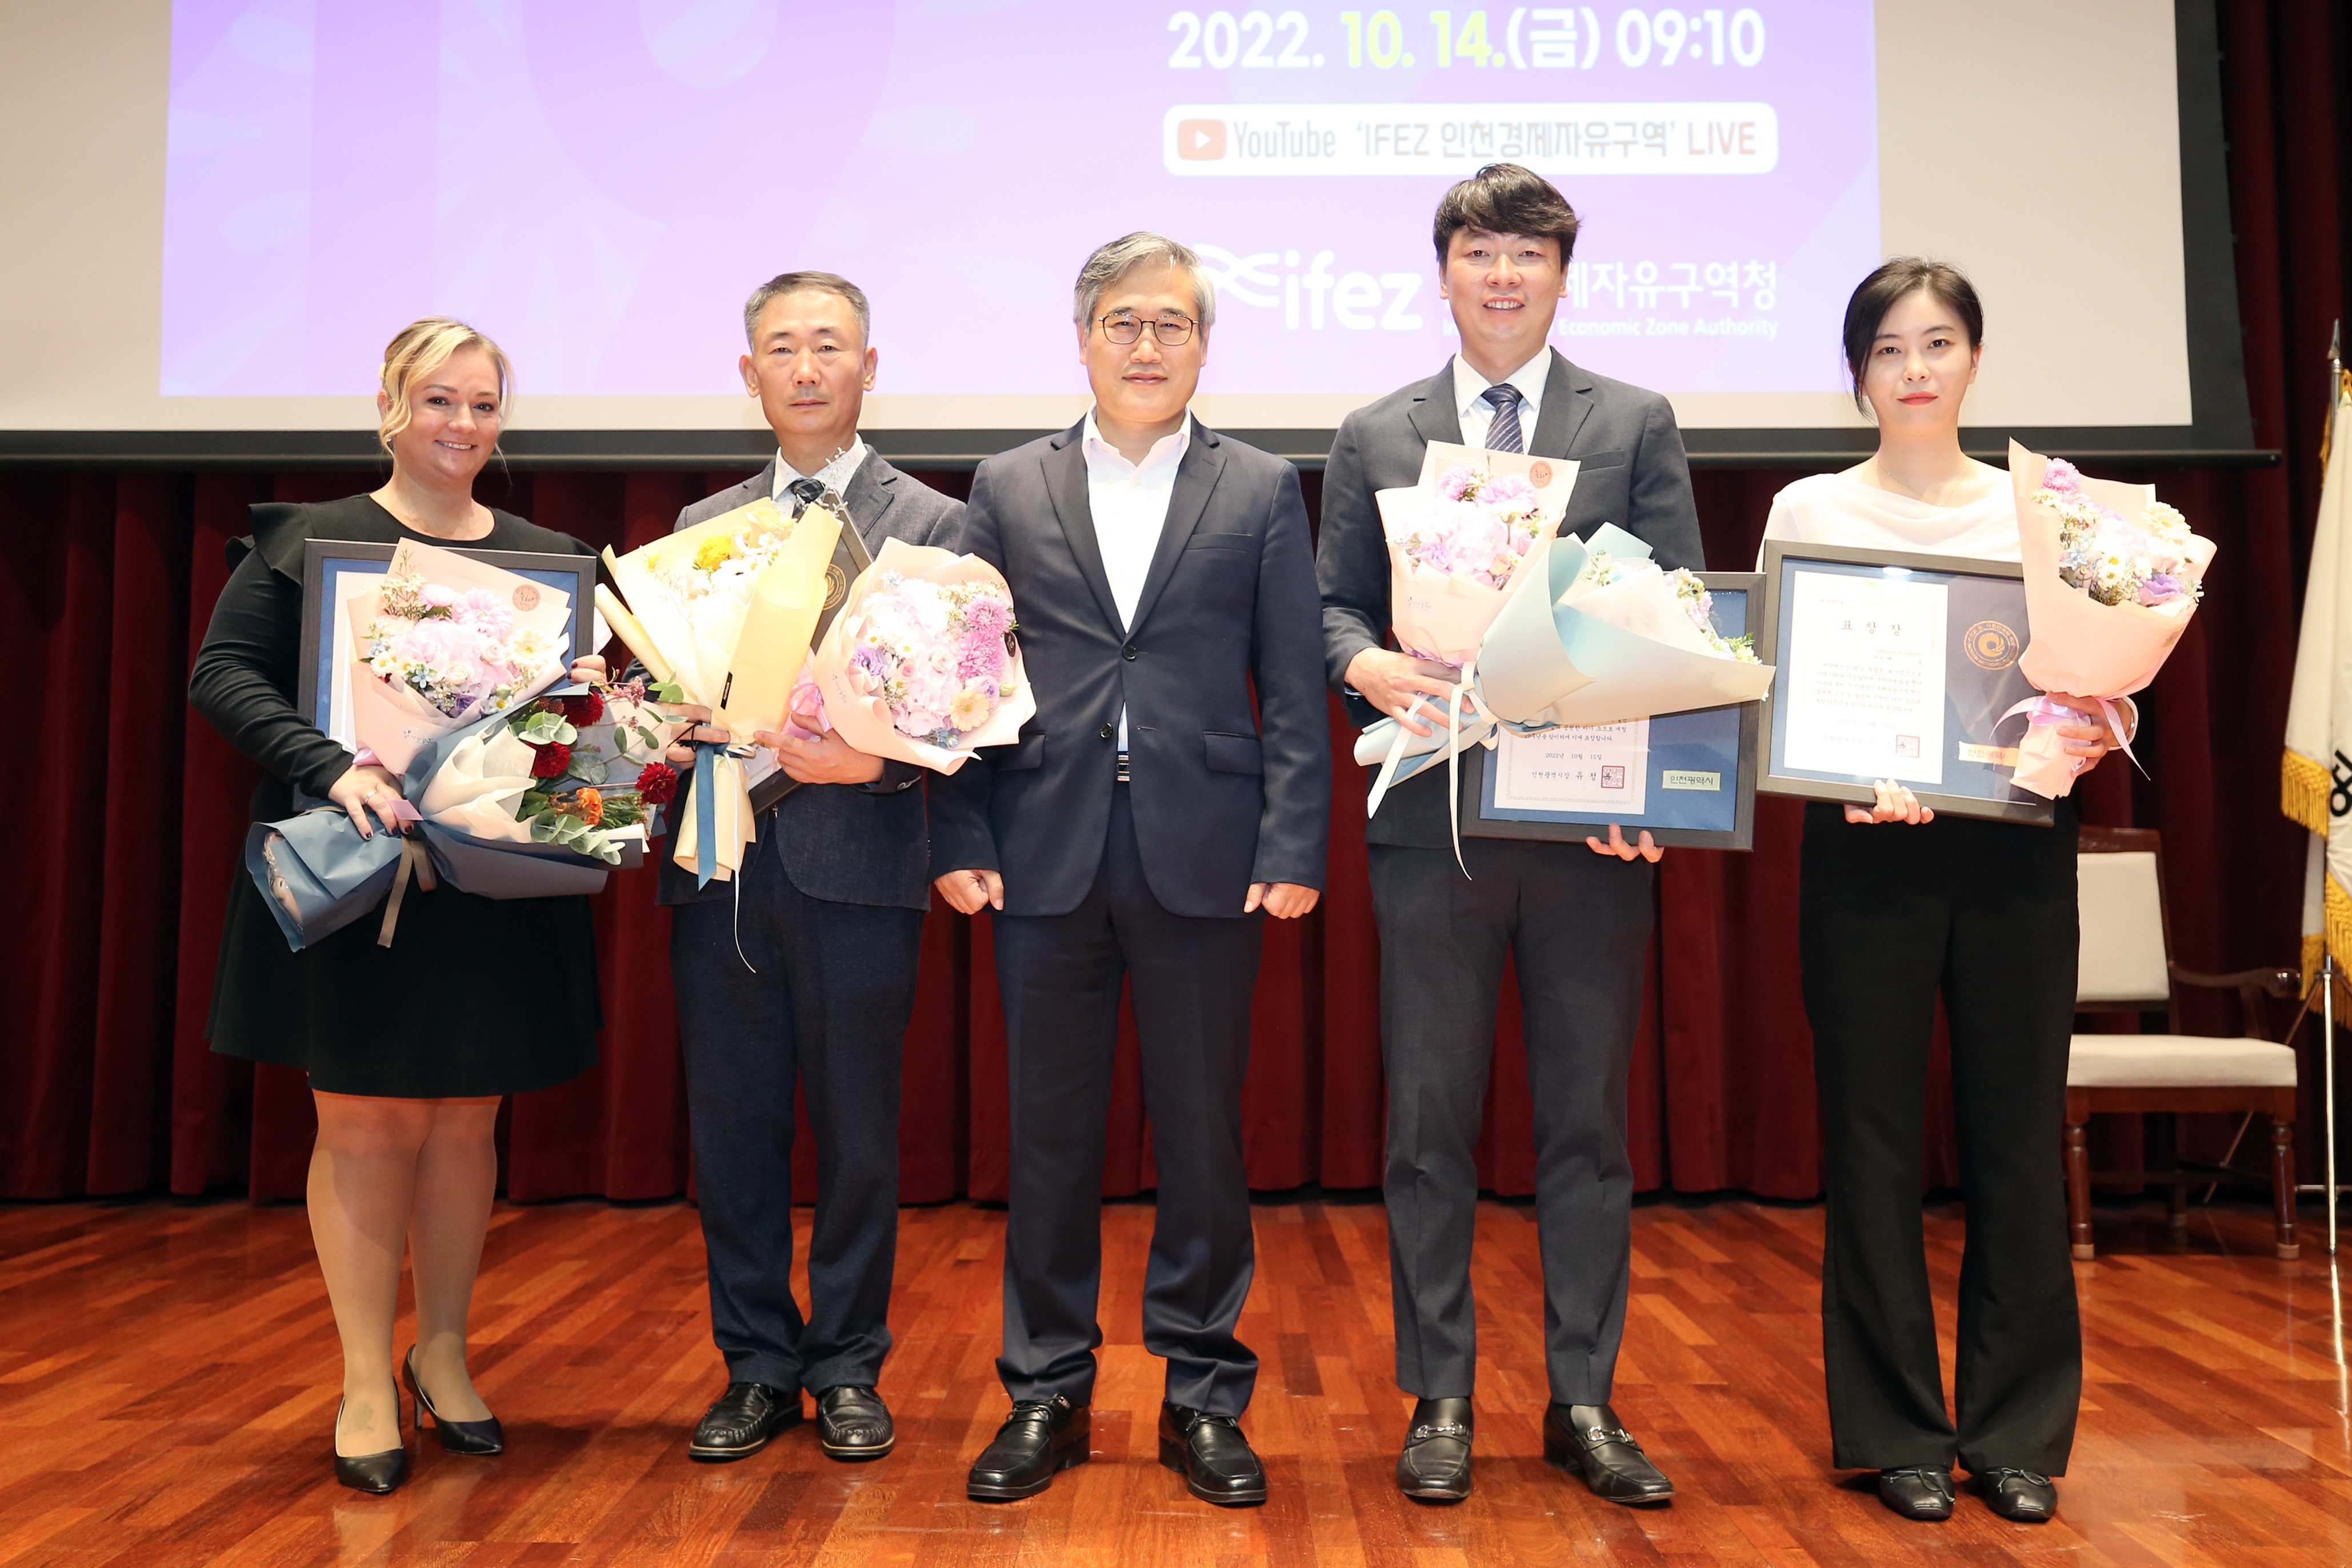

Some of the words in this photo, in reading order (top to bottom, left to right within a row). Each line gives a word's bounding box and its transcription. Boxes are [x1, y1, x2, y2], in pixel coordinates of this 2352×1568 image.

[1167, 10, 1325, 69] 2022.
[1340, 10, 1415, 69] 10.
[1615, 8, 1766, 68] 09:10
[1233, 120, 1337, 158] YouTube
[1687, 121, 1757, 155] LIVE
[1283, 248, 1423, 331] ifez
[1567, 259, 1777, 311] 제자유구역청
[1558, 317, 1641, 336] Economic
[1645, 318, 1689, 336] Zone
[1694, 316, 1779, 340] Authority
[1531, 770, 1570, 779] 인천광역시장
[1670, 775, 1714, 786] 인천광역시
